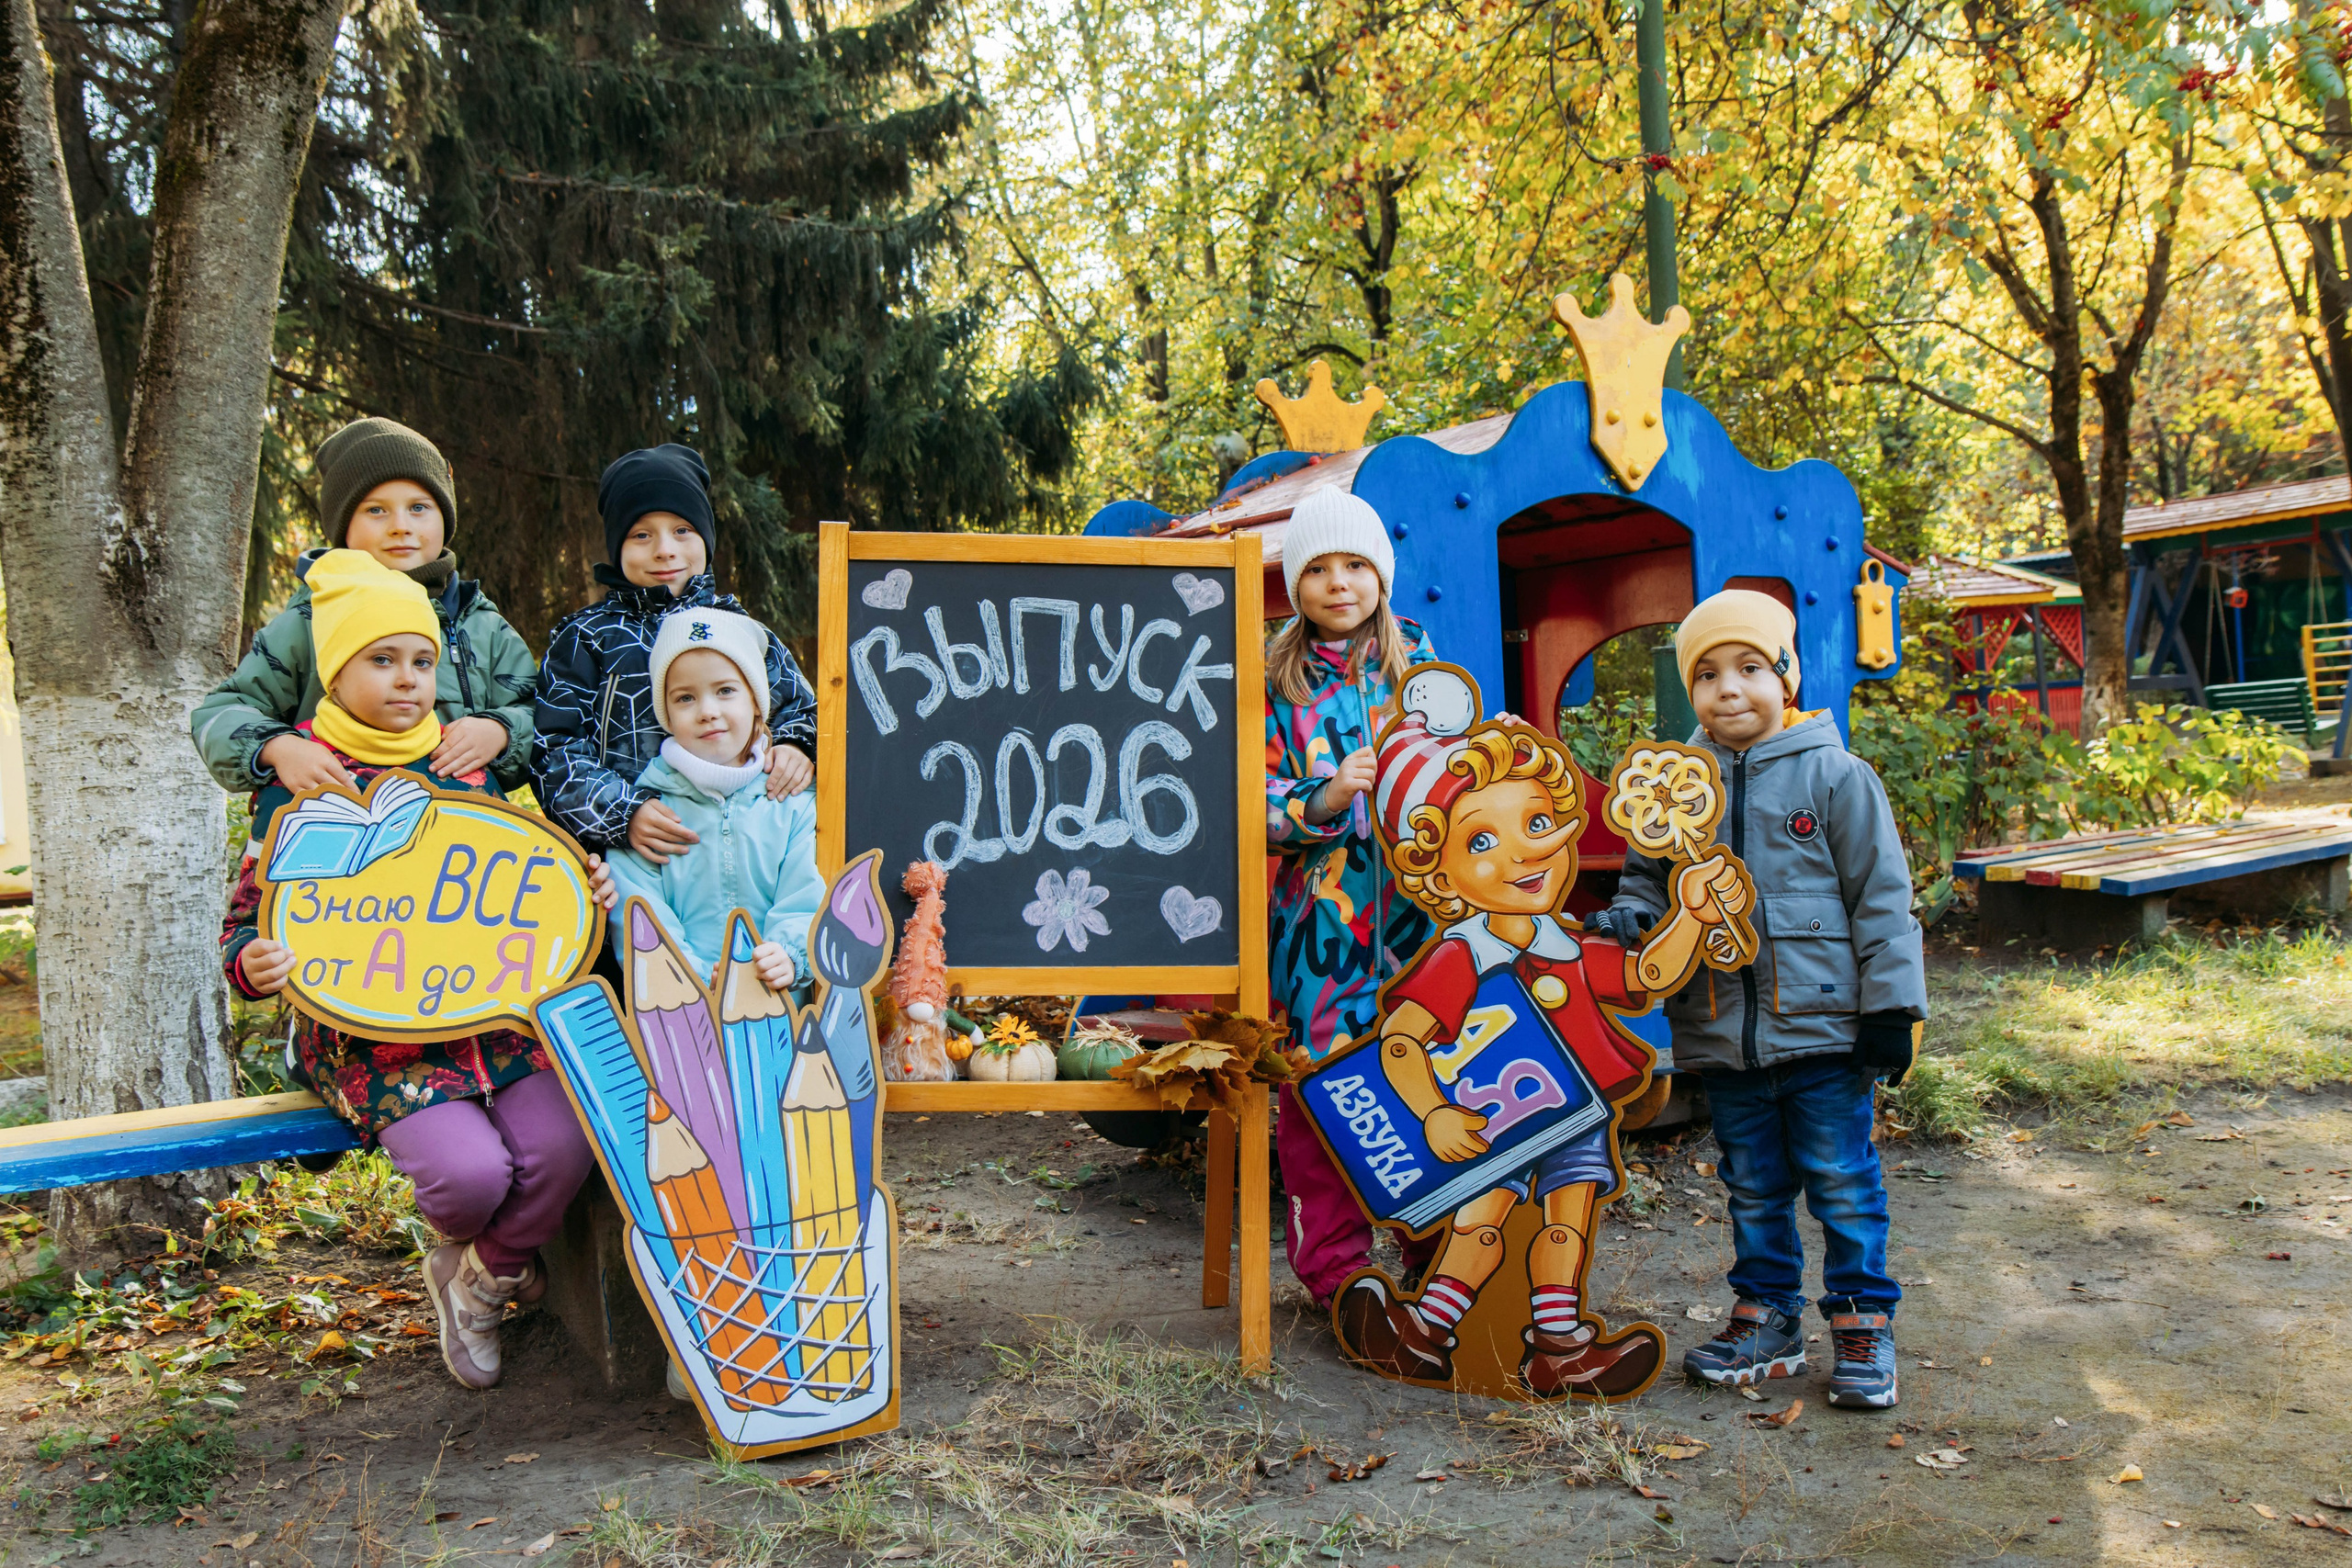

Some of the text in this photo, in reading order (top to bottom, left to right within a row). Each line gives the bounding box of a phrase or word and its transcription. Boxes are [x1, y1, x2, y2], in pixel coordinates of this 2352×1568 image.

[849, 597, 1235, 735] ВЫПУСК
[920, 720, 1200, 871] 2026
[289, 843, 556, 929] Знаю ВСЁ
[301, 956, 355, 987] от
[361, 927, 406, 993] А
[417, 964, 476, 1017] до
[1322, 1074, 1424, 1200] АЗБУКА
[1454, 1058, 1567, 1145] Я
